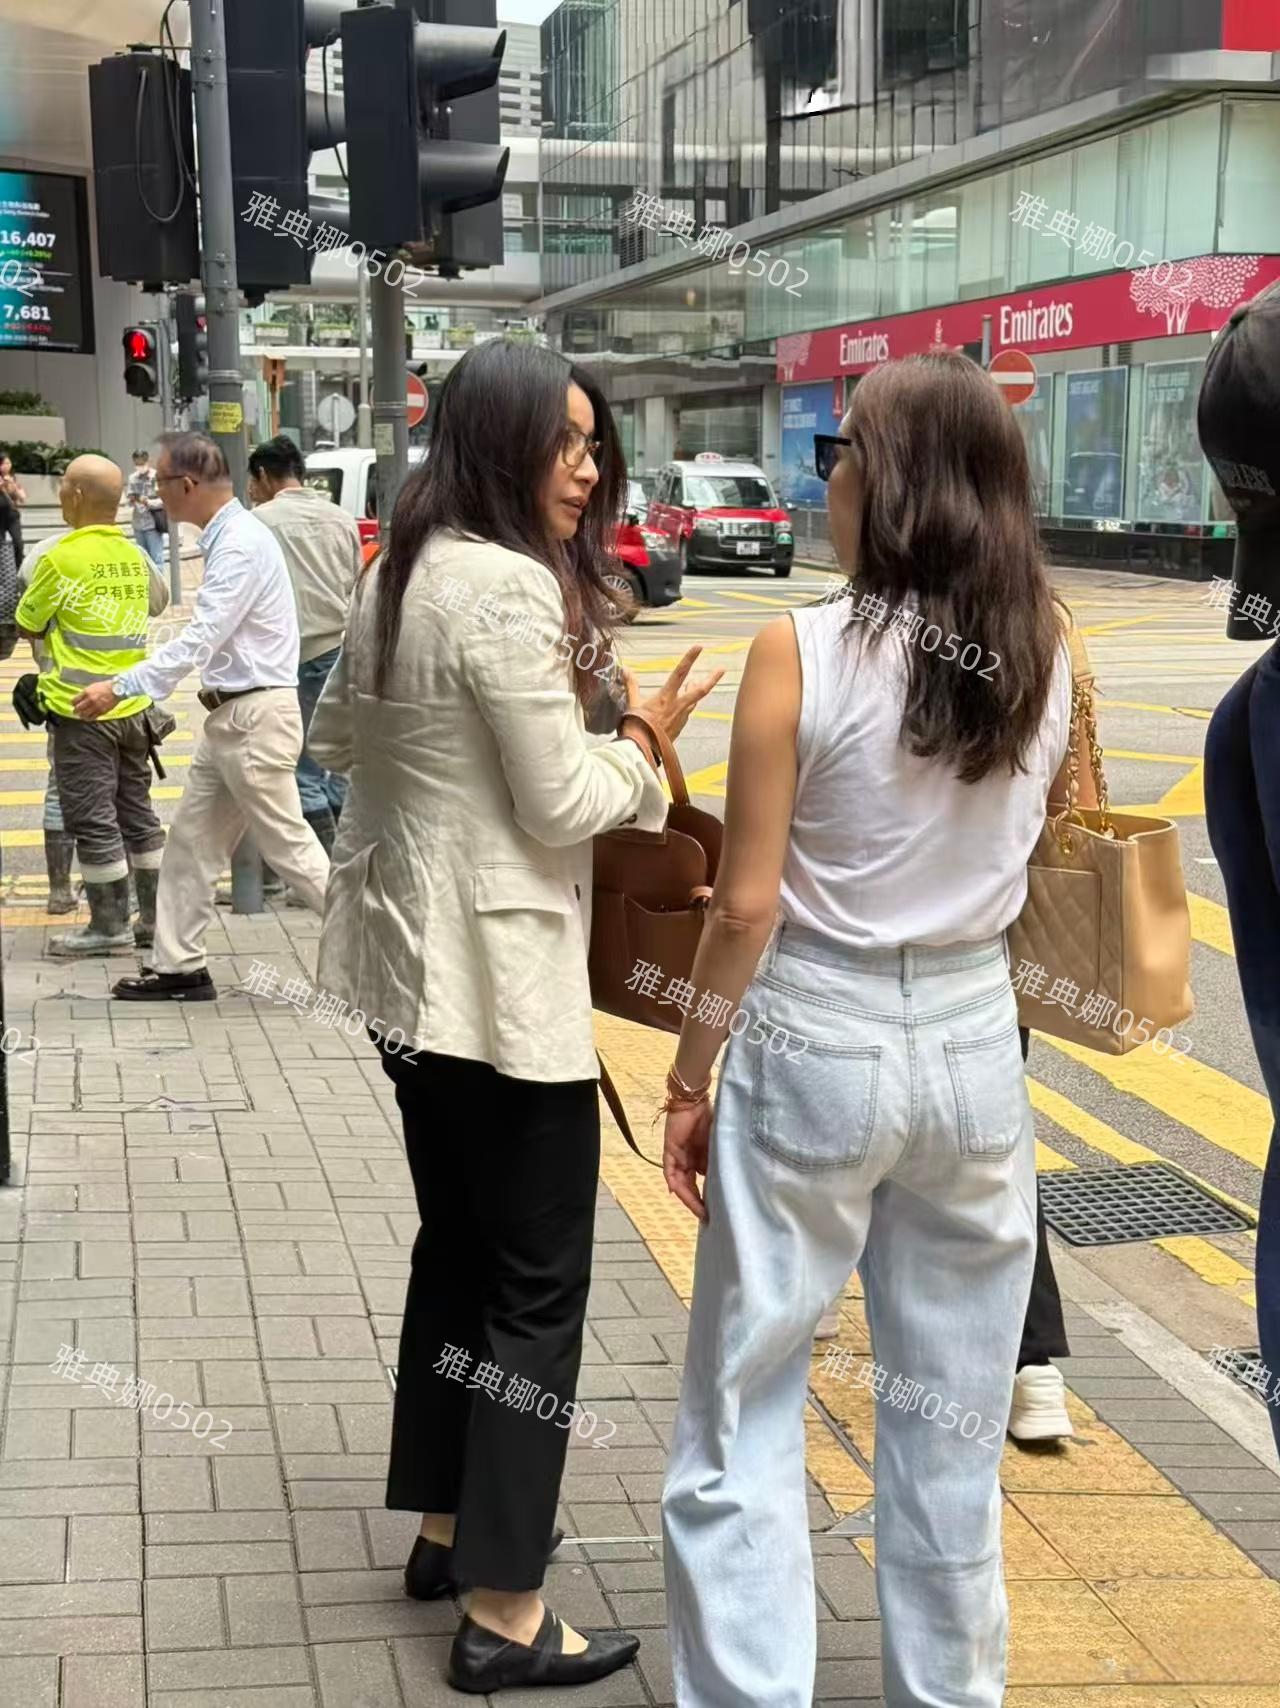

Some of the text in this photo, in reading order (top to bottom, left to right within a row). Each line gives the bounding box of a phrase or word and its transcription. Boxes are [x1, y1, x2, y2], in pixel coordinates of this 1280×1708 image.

[0, 230, 56, 248] 16,407
[3, 304, 51, 321] 7,681
[1000, 299, 1073, 345] Emirates
[840, 330, 889, 366] Emirates
